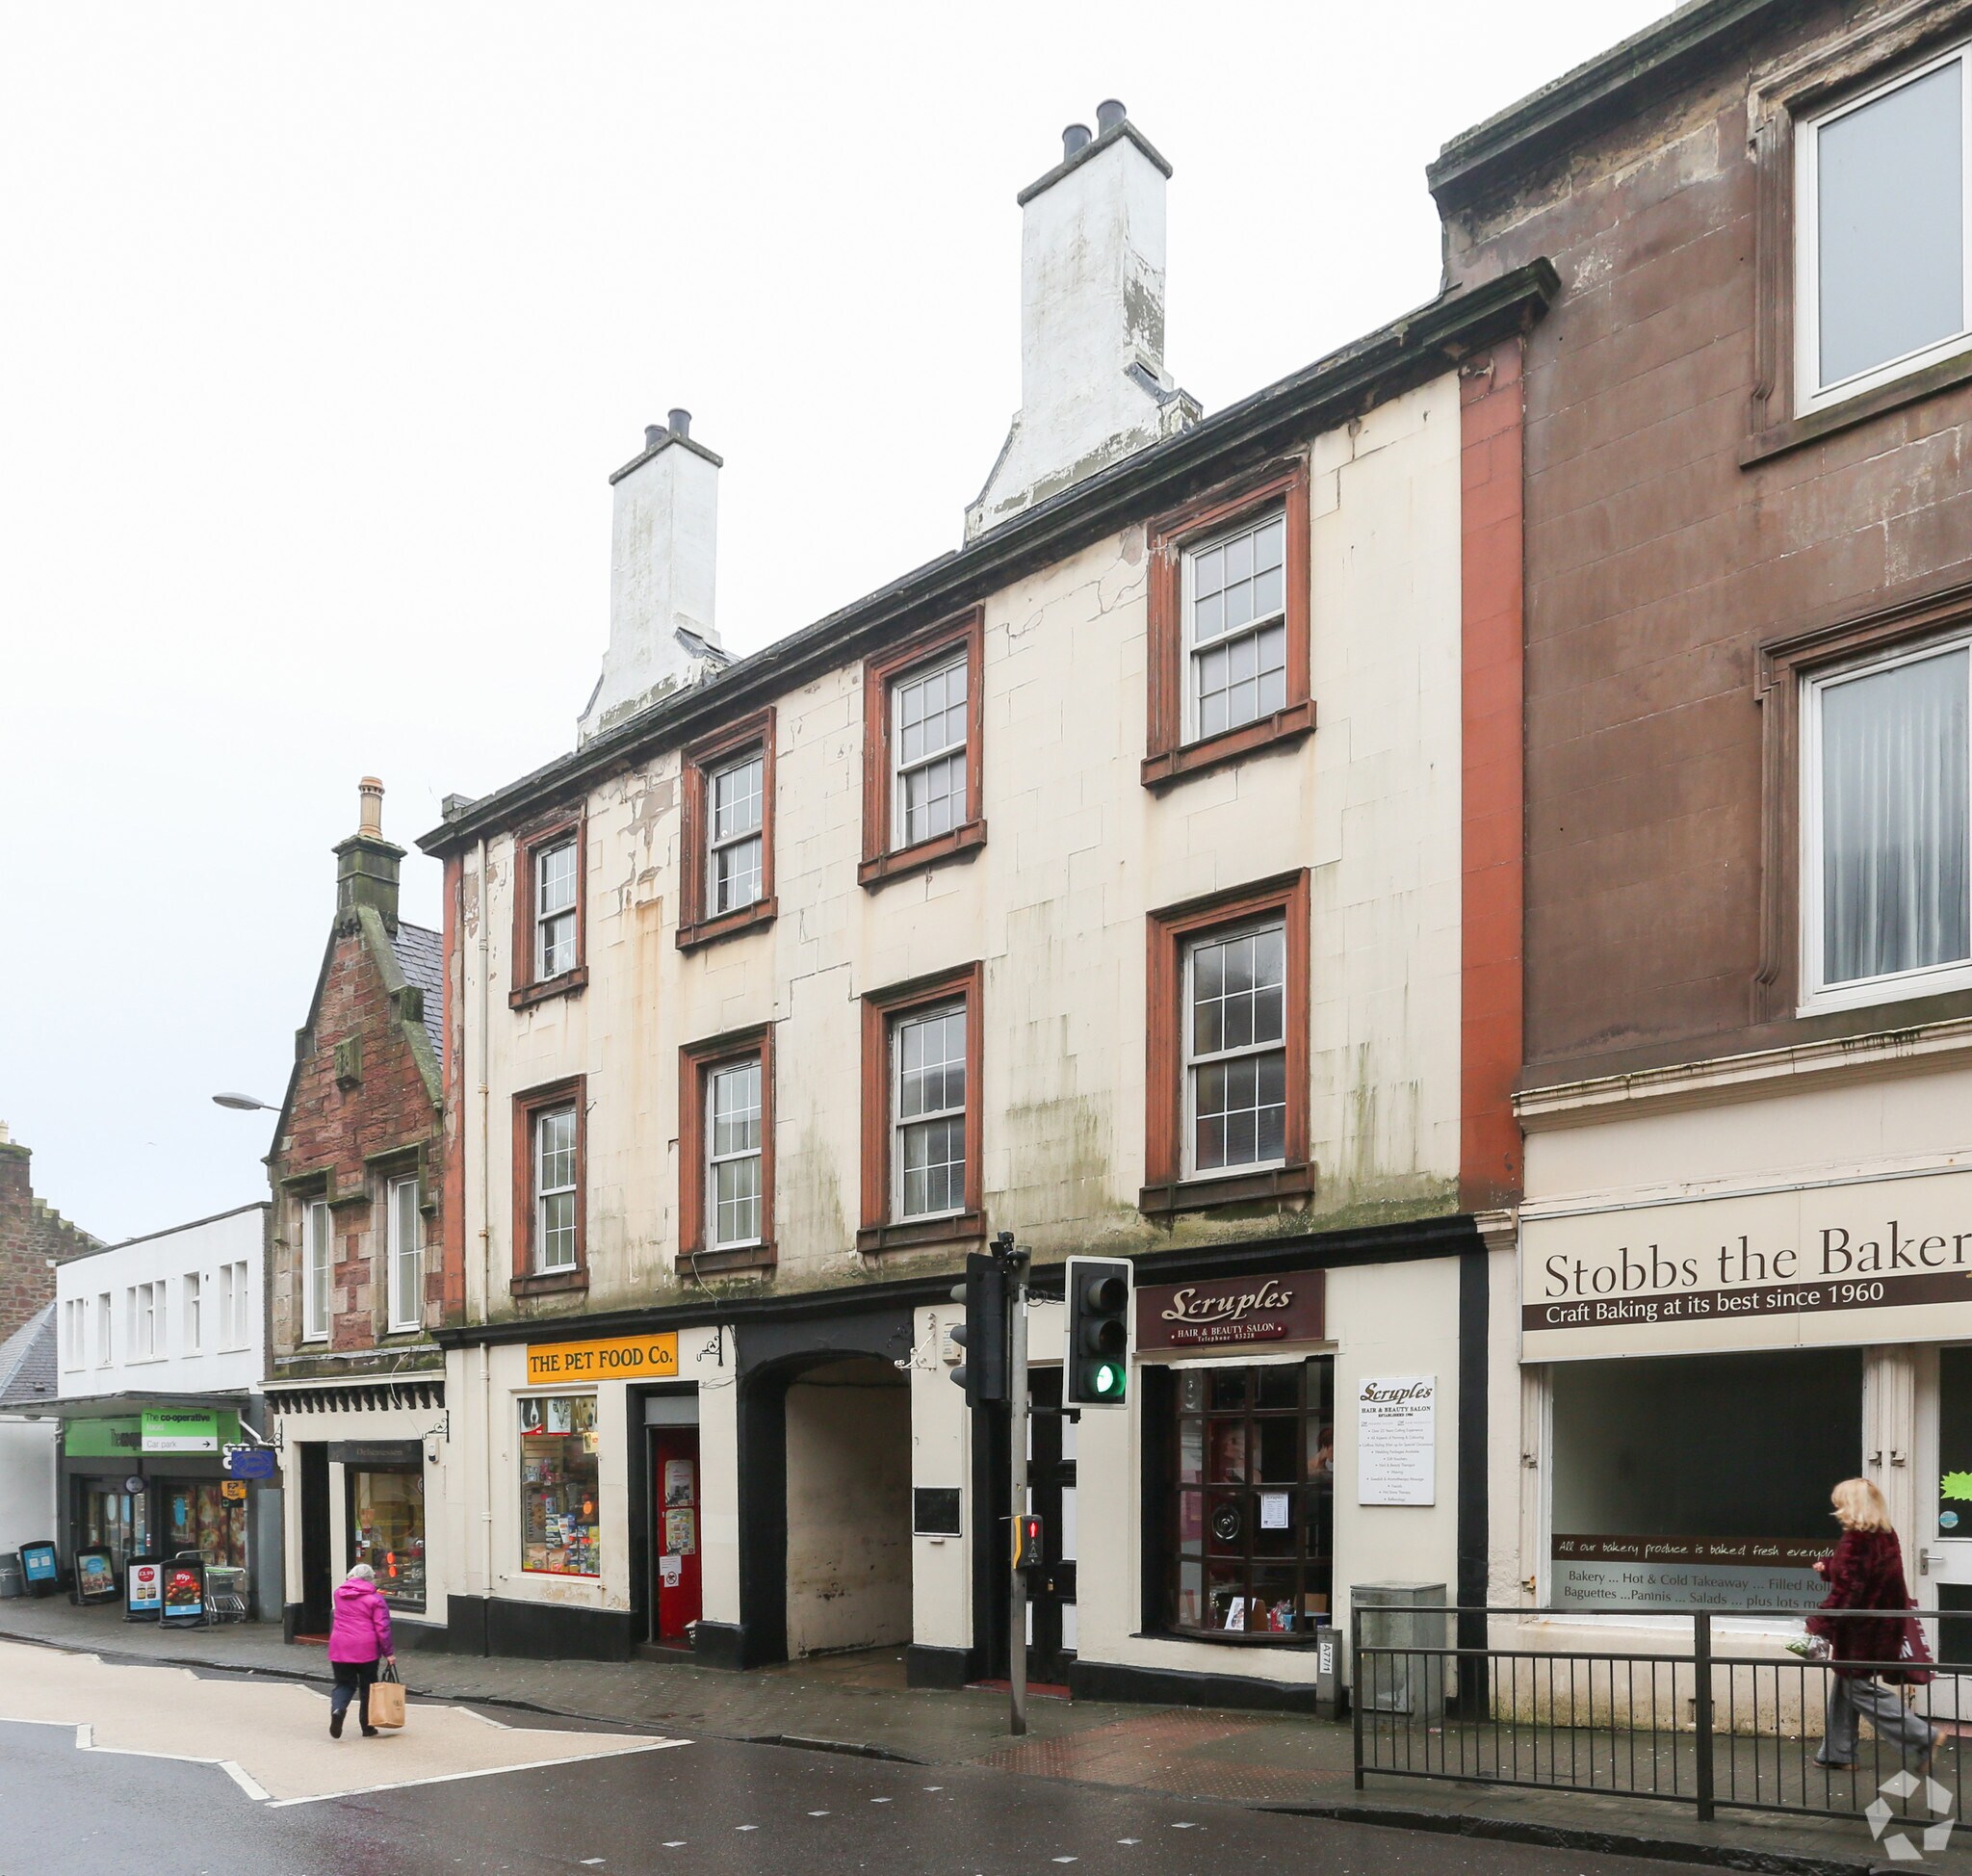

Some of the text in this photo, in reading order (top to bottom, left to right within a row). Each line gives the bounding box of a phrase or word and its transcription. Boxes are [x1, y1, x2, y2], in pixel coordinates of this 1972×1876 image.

[1545, 1220, 1972, 1297] Stobbs the Baker
[1161, 1280, 1293, 1322] Scruples
[1546, 1282, 1884, 1323] Craft Baking at its best since 1960
[1178, 1322, 1275, 1338] HAIR & BEAUTY SALON
[530, 1345, 673, 1372] THE PET FOOD Co.
[1360, 1382, 1433, 1404] Scruples
[145, 1413, 210, 1422] The co-operative
[146, 1440, 177, 1449] Car park
[1559, 1541, 1834, 1560] All our bakery produce is baked fresh everyda
[1569, 1571, 1605, 1585] Bakery
[1622, 1573, 1644, 1584] Hot
[1648, 1574, 1656, 1584] &
[1660, 1575, 1688, 1586] Cold
[1691, 1575, 1749, 1591] Takeaway
[1769, 1578, 1802, 1591] Filled
[1806, 1580, 1832, 1592] Roll
[1564, 1586, 1617, 1601] Baguettes
[1690, 1593, 1727, 1605] Salads
[1747, 1595, 1773, 1609] plus
[1777, 1596, 1799, 1608] lots
[1323, 1644, 1332, 1671] A77/1
